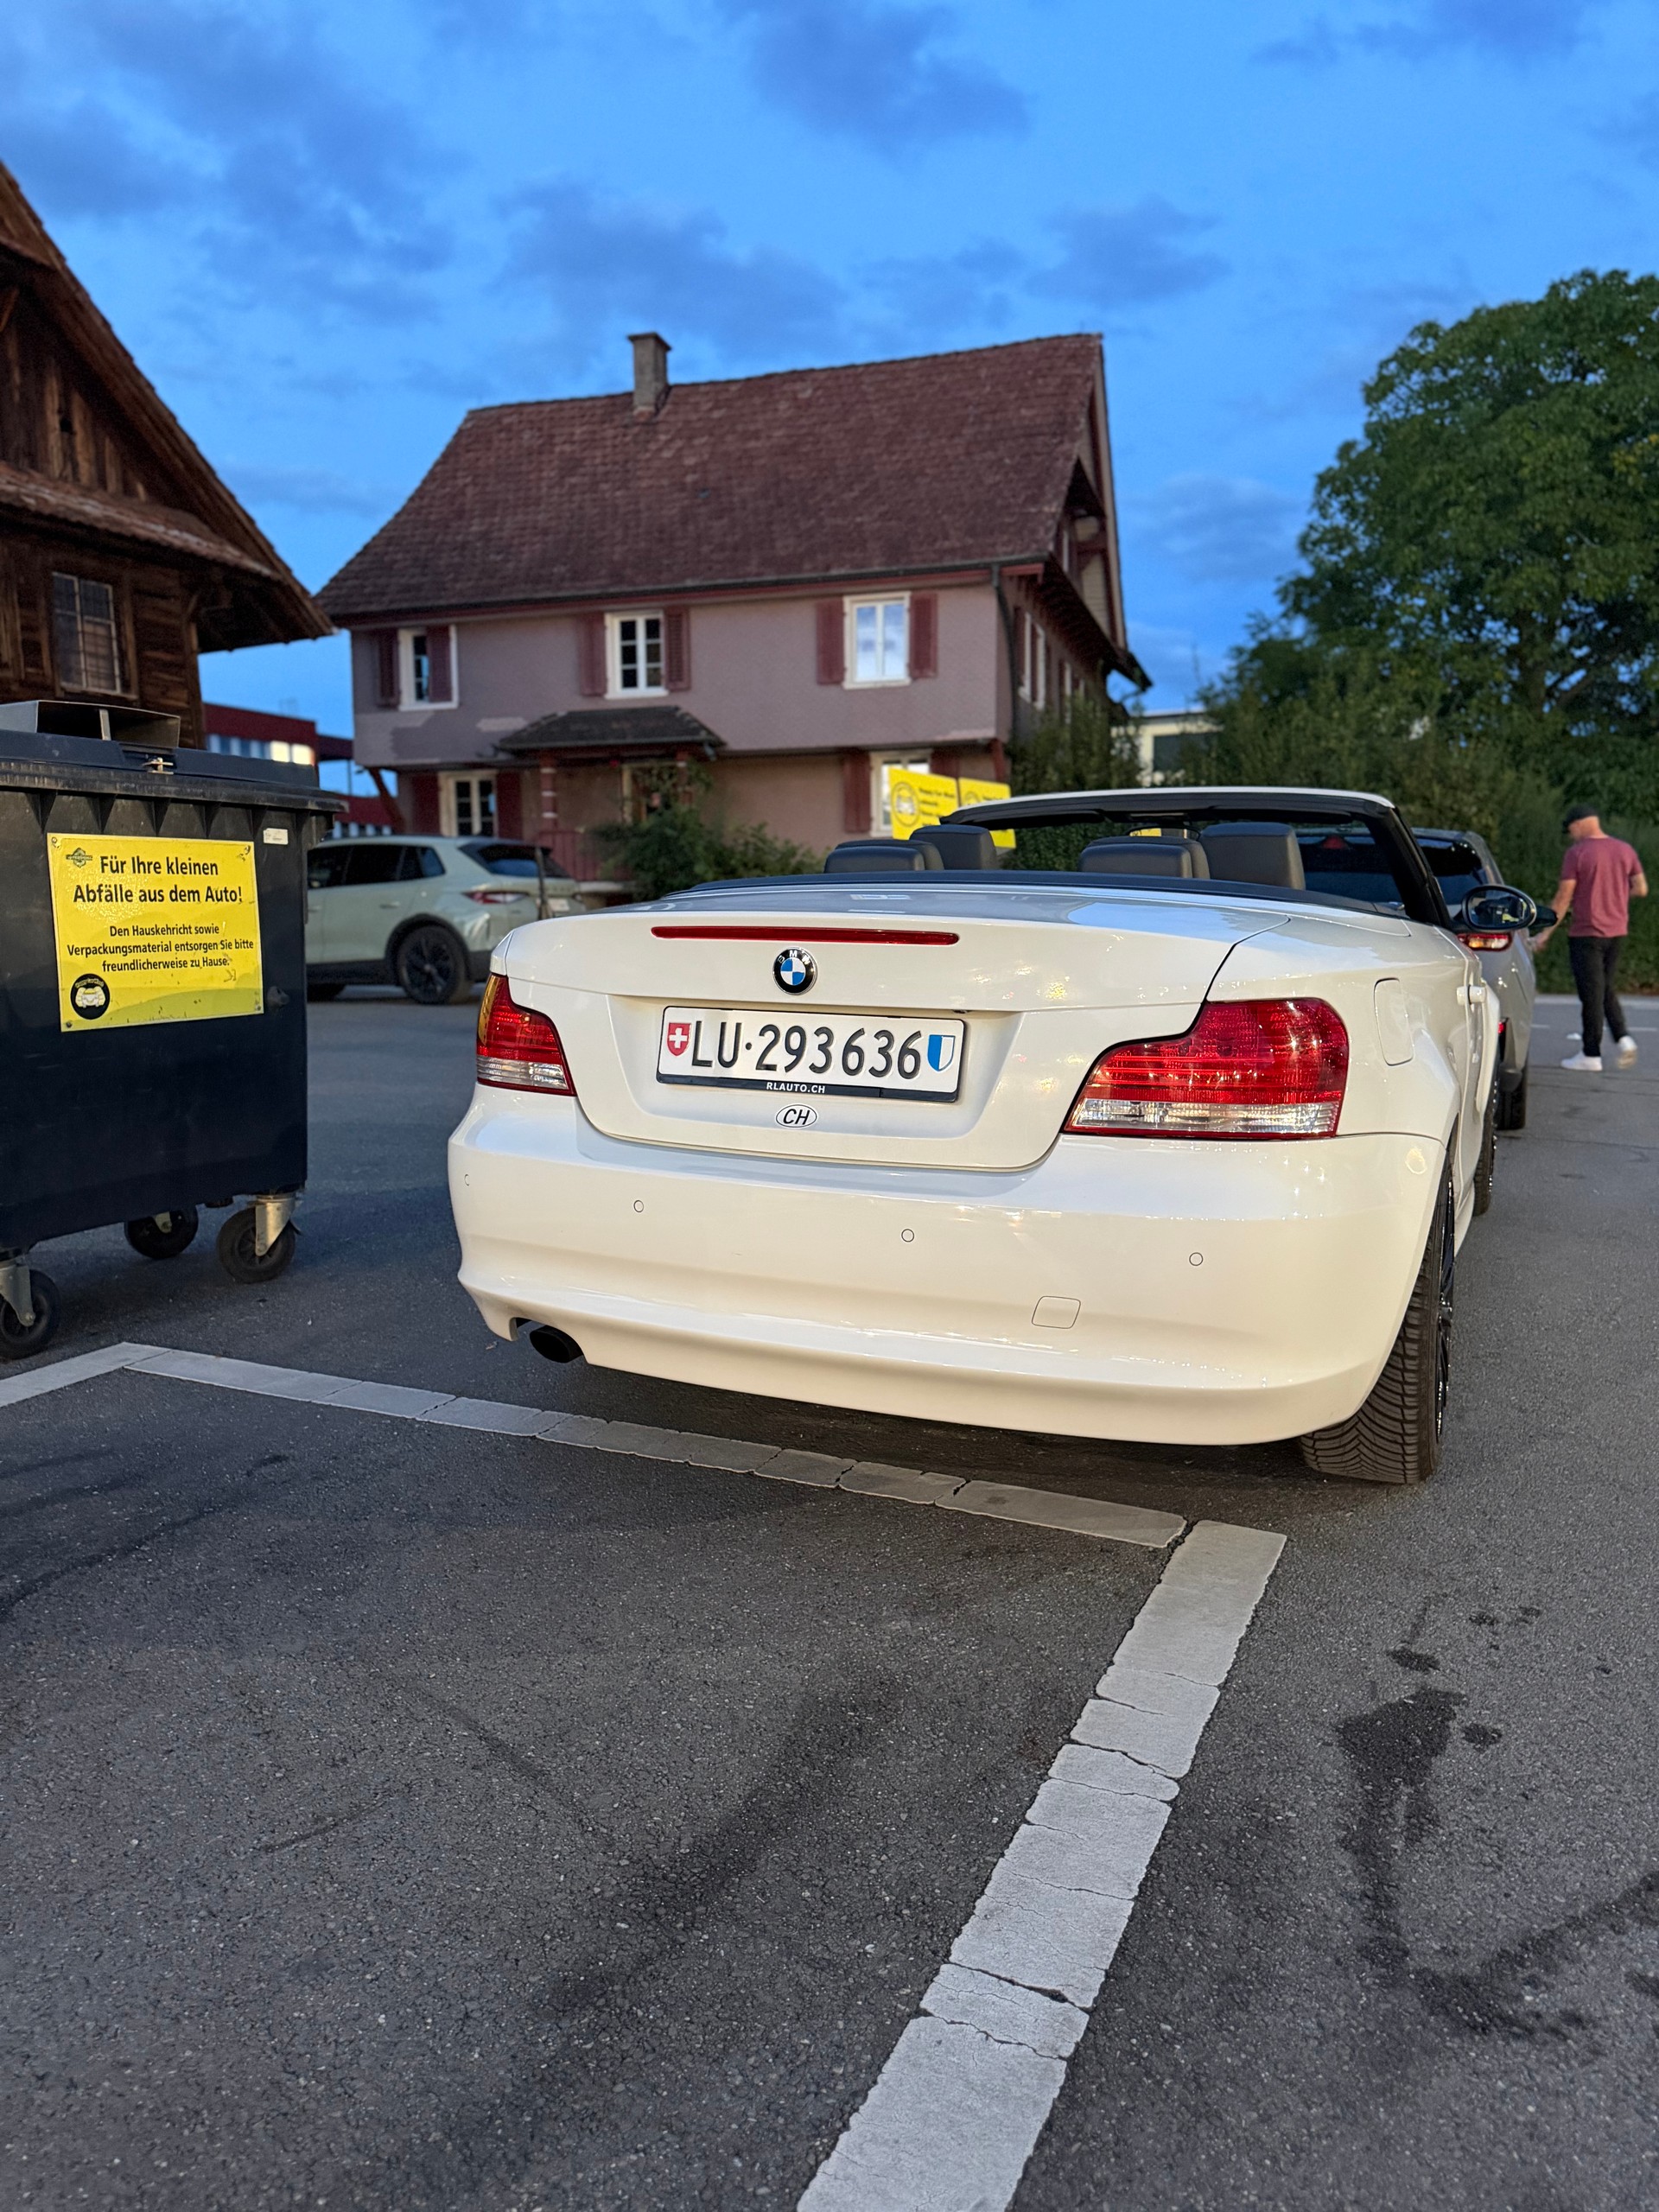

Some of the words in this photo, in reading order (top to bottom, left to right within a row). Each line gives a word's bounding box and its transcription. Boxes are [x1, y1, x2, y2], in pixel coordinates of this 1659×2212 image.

[100, 855, 126, 874] Für
[131, 857, 162, 874] Ihre
[167, 856, 219, 875] kleinen
[73, 884, 133, 903] Abfälle
[138, 889, 164, 902] aus
[169, 885, 200, 902] dem
[205, 887, 243, 902] Auto!
[110, 925, 129, 937] Den
[132, 925, 192, 936] Hauskehricht
[194, 924, 219, 935] sowie
[67, 941, 171, 957] Verpackungsmaterial
[175, 943, 218, 954] entsorgen
[219, 940, 232, 950] Sie
[235, 938, 254, 950] bitte
[102, 960, 188, 972] freundlicherweise
[190, 959, 200, 968] zu
[202, 957, 230, 967] Hause.
[777, 950, 810, 964] BMW
[766, 1081, 826, 1094] RLAUTO.CH
[782, 1108, 810, 1126] CH
